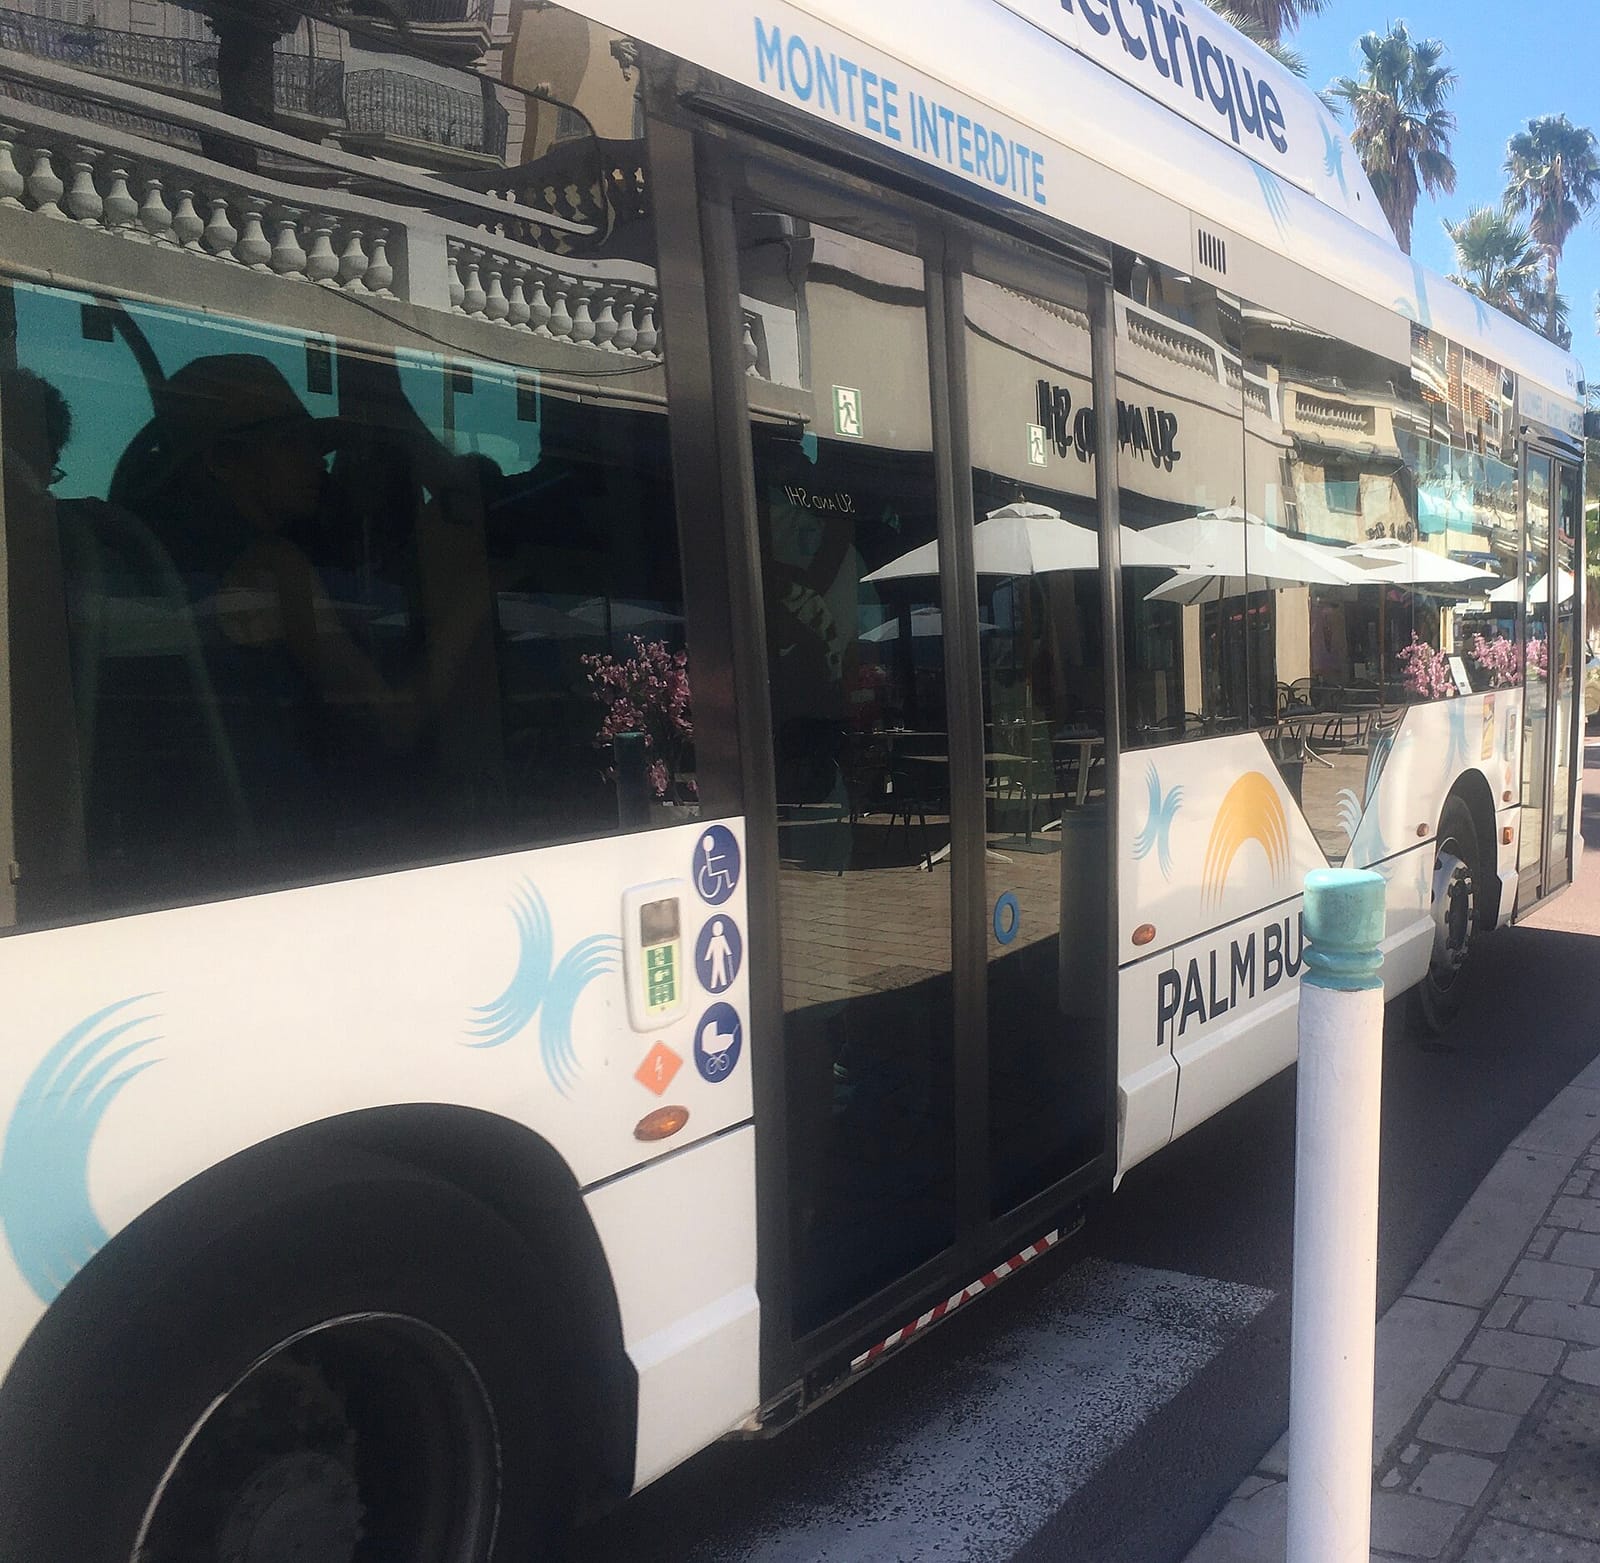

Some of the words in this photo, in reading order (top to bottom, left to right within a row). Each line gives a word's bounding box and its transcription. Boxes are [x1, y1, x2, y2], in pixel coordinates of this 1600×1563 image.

[753, 16, 902, 143] MONTEE
[909, 91, 1046, 205] INTERDITE
[1157, 932, 1255, 1047] PALM
